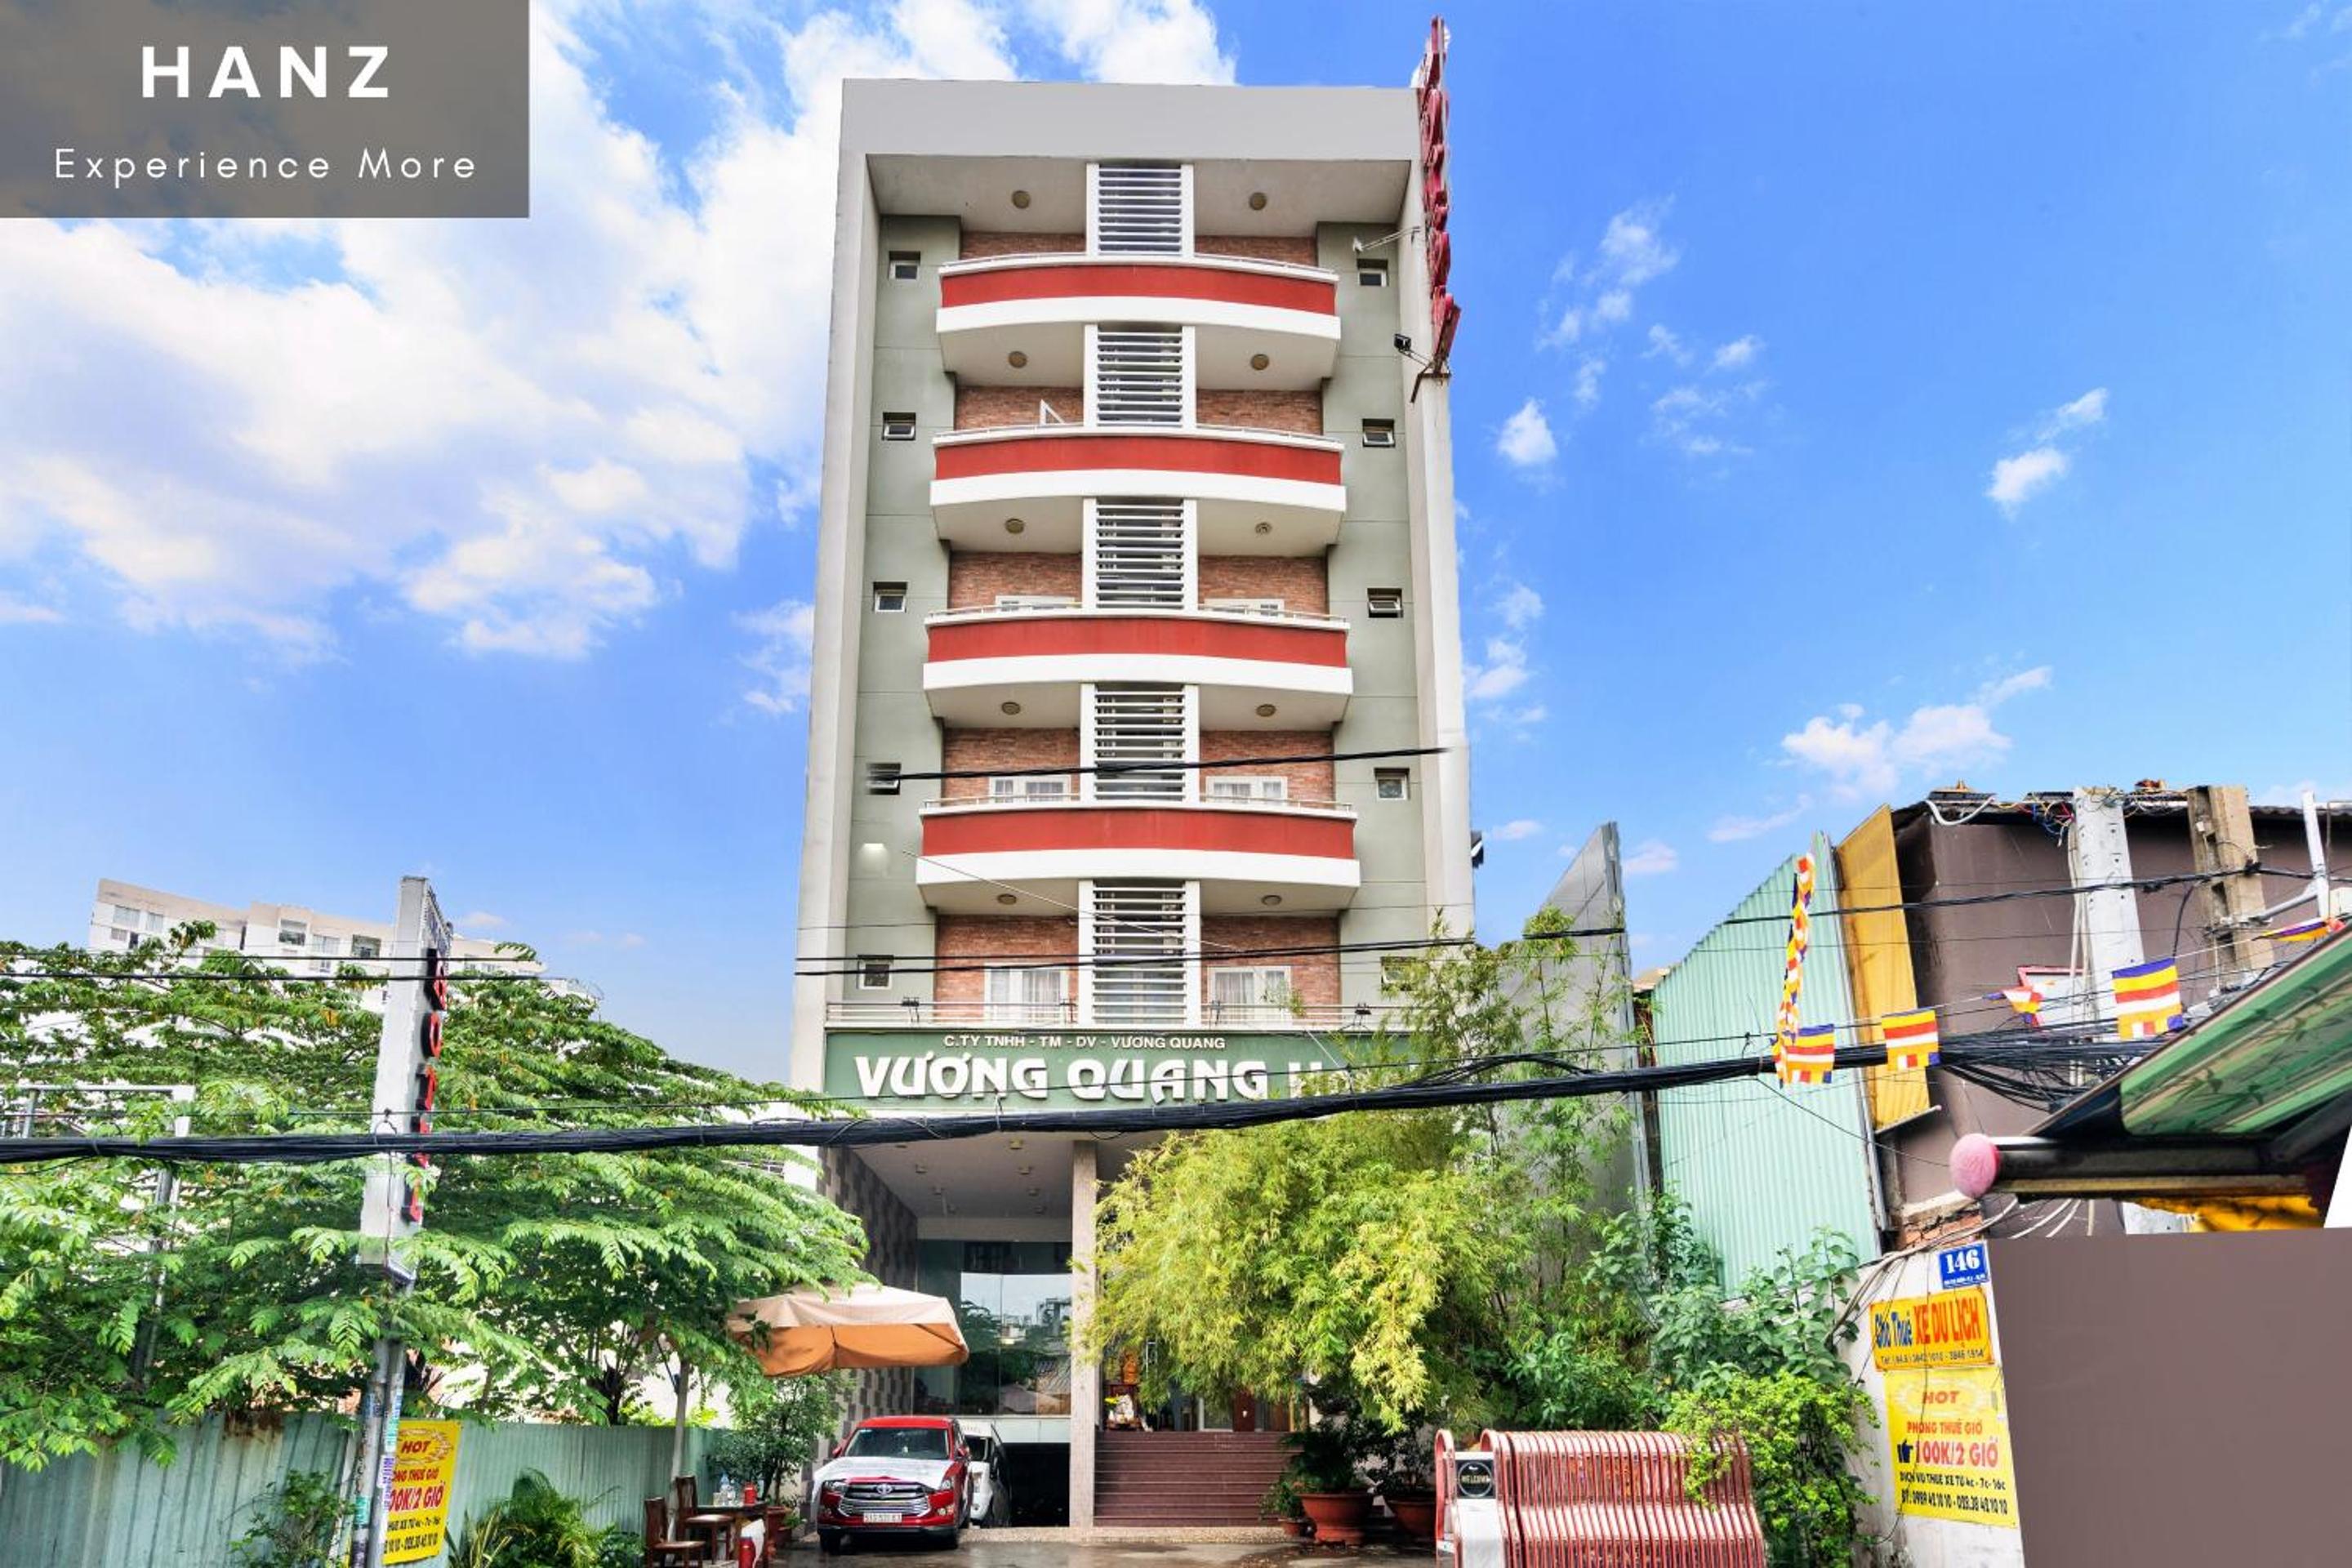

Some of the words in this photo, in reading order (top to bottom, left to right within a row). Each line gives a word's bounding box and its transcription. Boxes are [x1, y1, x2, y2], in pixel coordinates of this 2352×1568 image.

[944, 1035, 980, 1047] C.TY
[985, 1036, 1026, 1047] TNHH
[1039, 1036, 1062, 1047] TM
[1076, 1036, 1097, 1048] DV
[1111, 1036, 1166, 1049] VƯƠNG
[1169, 1037, 1226, 1049] QUANG
[855, 1051, 1048, 1099] VƯƠNG
[1067, 1057, 1267, 1105] QUANG
[1946, 1250, 1980, 1274] 146
[1914, 1304, 1931, 1344] XE
[1931, 1303, 1949, 1343] DU
[1922, 1391, 1959, 1404] HOT
[401, 1441, 432, 1454] HOT
